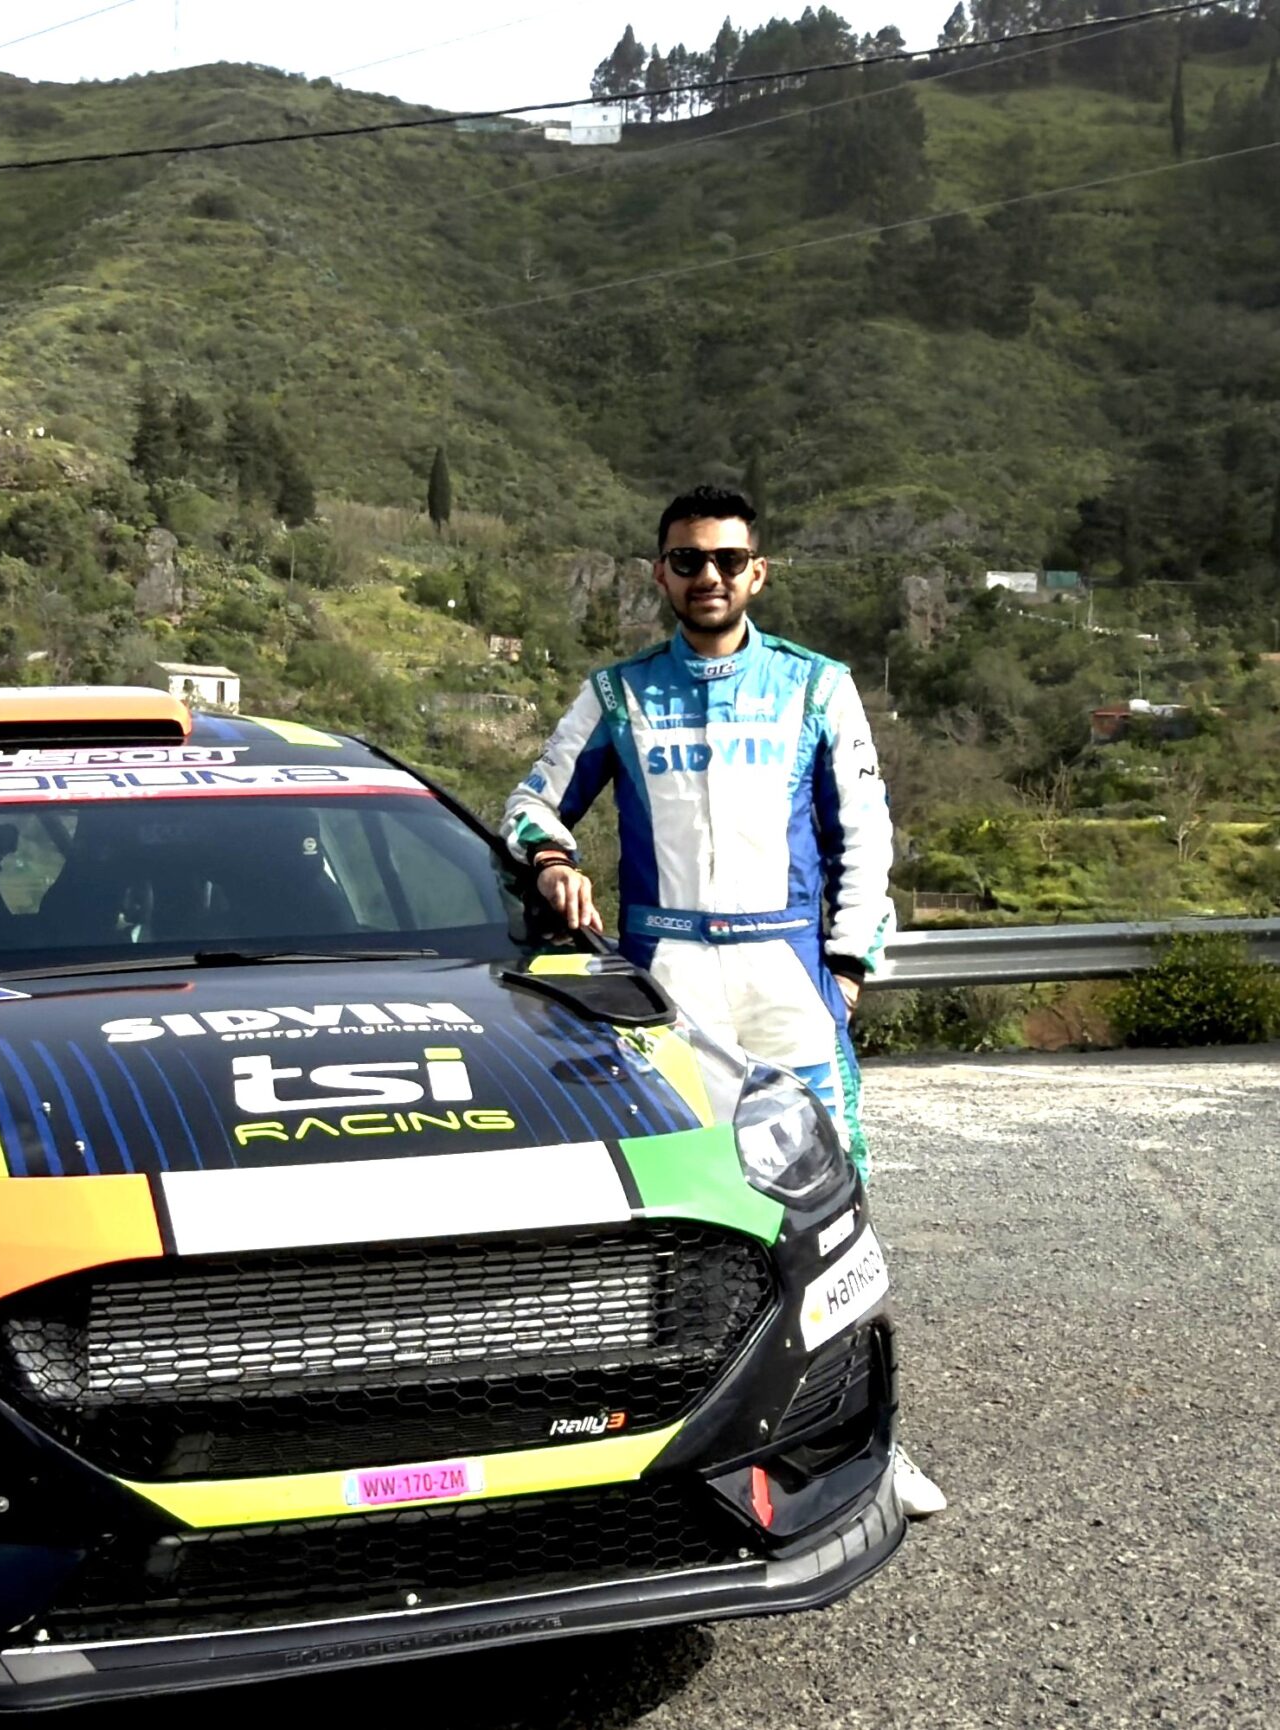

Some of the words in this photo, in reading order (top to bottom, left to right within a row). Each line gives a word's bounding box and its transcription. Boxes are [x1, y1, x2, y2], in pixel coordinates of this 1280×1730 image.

[647, 738, 785, 775] SIDVIN
[645, 914, 692, 931] sparco
[101, 1002, 475, 1042] SIDVIN
[220, 1028, 319, 1041] energy
[328, 1019, 485, 1036] engineering
[232, 1047, 474, 1114] tsi
[233, 1109, 516, 1147] RACING
[363, 1469, 465, 1498] WW-170-ZM
